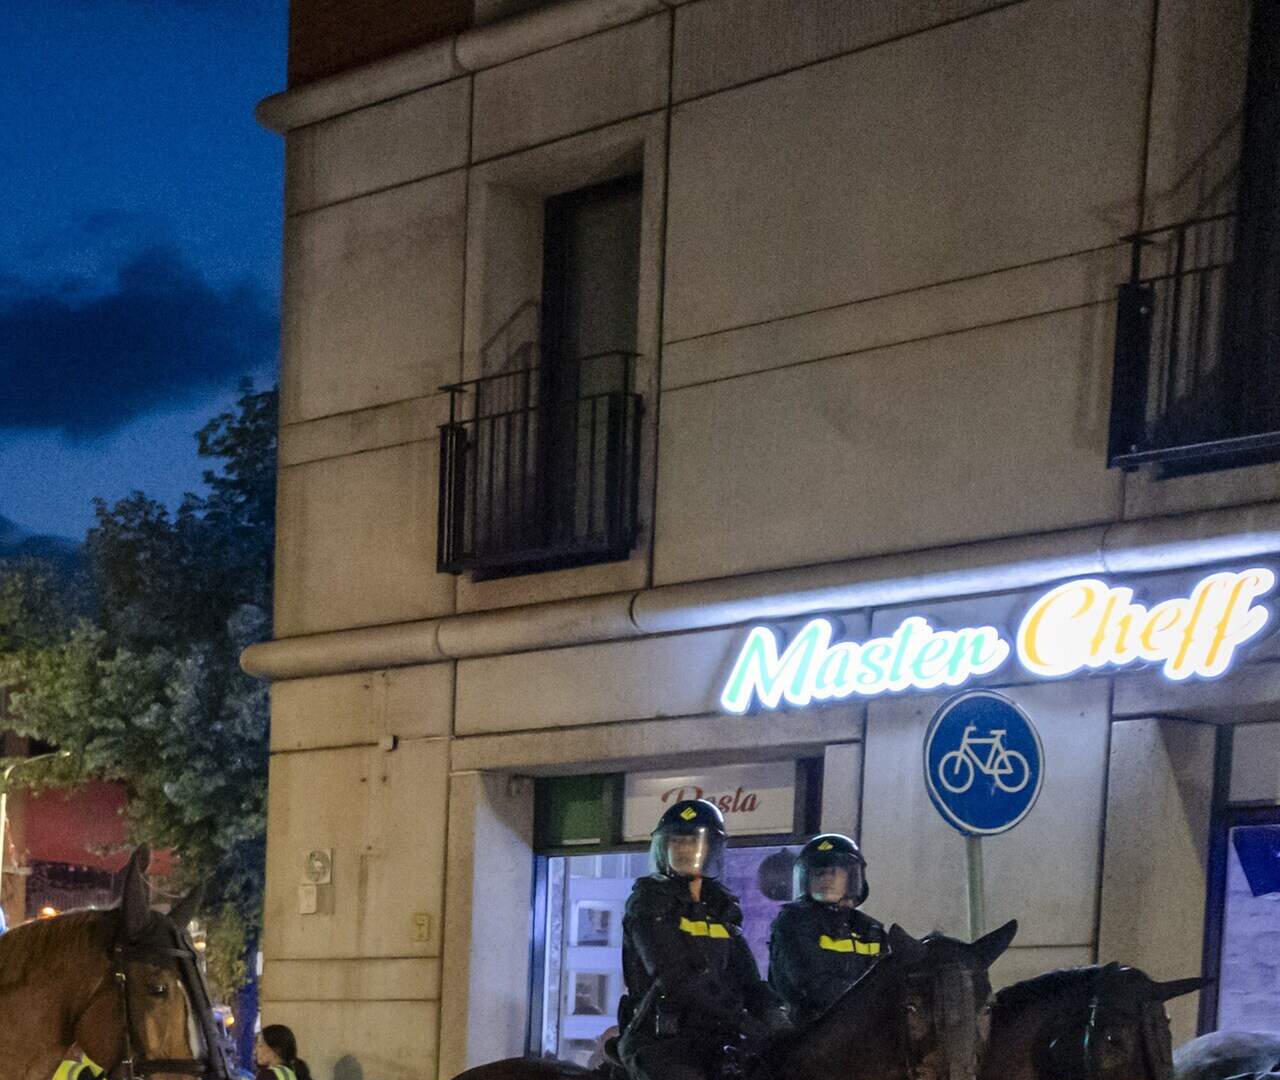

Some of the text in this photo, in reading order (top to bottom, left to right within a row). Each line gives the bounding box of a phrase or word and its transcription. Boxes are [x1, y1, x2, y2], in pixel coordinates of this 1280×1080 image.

[724, 570, 1270, 708] Master Cheff
[661, 785, 760, 813] Psta
